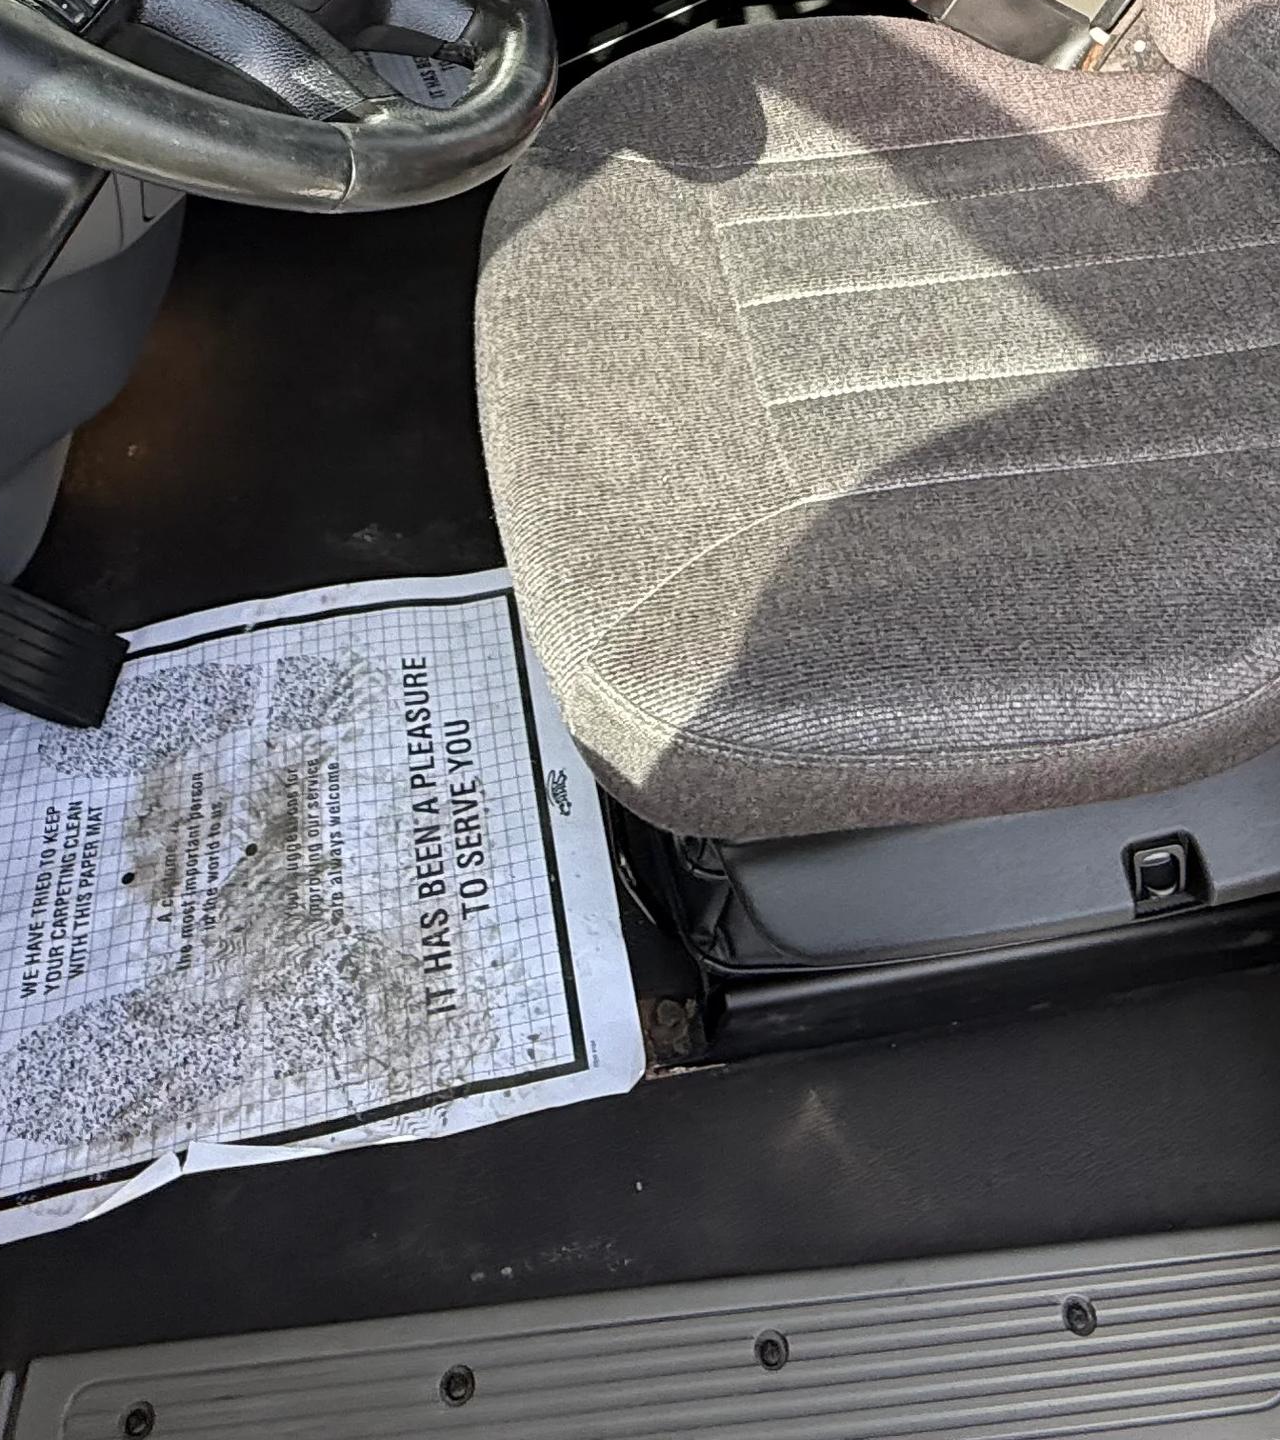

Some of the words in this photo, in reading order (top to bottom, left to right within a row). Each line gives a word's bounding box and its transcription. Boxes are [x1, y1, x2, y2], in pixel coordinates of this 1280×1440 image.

[401, 656, 437, 789] PLEASURE
[445, 717, 475, 773] YOU
[190, 772, 203, 819] person
[286, 767, 298, 785] for
[306, 757, 318, 808] service
[42, 806, 61, 843] KEEP
[62, 801, 84, 848] CLEAN
[85, 804, 103, 836] MAT
[309, 814, 320, 835] our
[412, 795, 439, 814] A
[450, 781, 485, 868] SERVE
[208, 822, 220, 837] to
[38, 847, 55, 866] TO
[78, 837, 99, 888] PAPER
[159, 838, 177, 906] ctome
[181, 824, 200, 895] important
[206, 841, 220, 883] world
[328, 830, 342, 883] always
[415, 824, 446, 899] BEEN
[31, 871, 51, 916] TRIED
[50, 852, 77, 939] CARPETING
[202, 887, 218, 910] the
[306, 843, 323, 915] mproving
[460, 878, 491, 919] TO
[73, 892, 92, 928] THIS
[156, 912, 172, 924] A
[179, 899, 195, 937] most
[202, 916, 216, 930] in
[332, 891, 343, 916] are
[24, 921, 45, 964] HAVE
[67, 933, 88, 979] WITH
[174, 944, 192, 969] the
[421, 908, 453, 973] HAS
[19, 967, 38, 998] WE
[42, 945, 64, 995] YOUR
[425, 986, 457, 1015] IT
